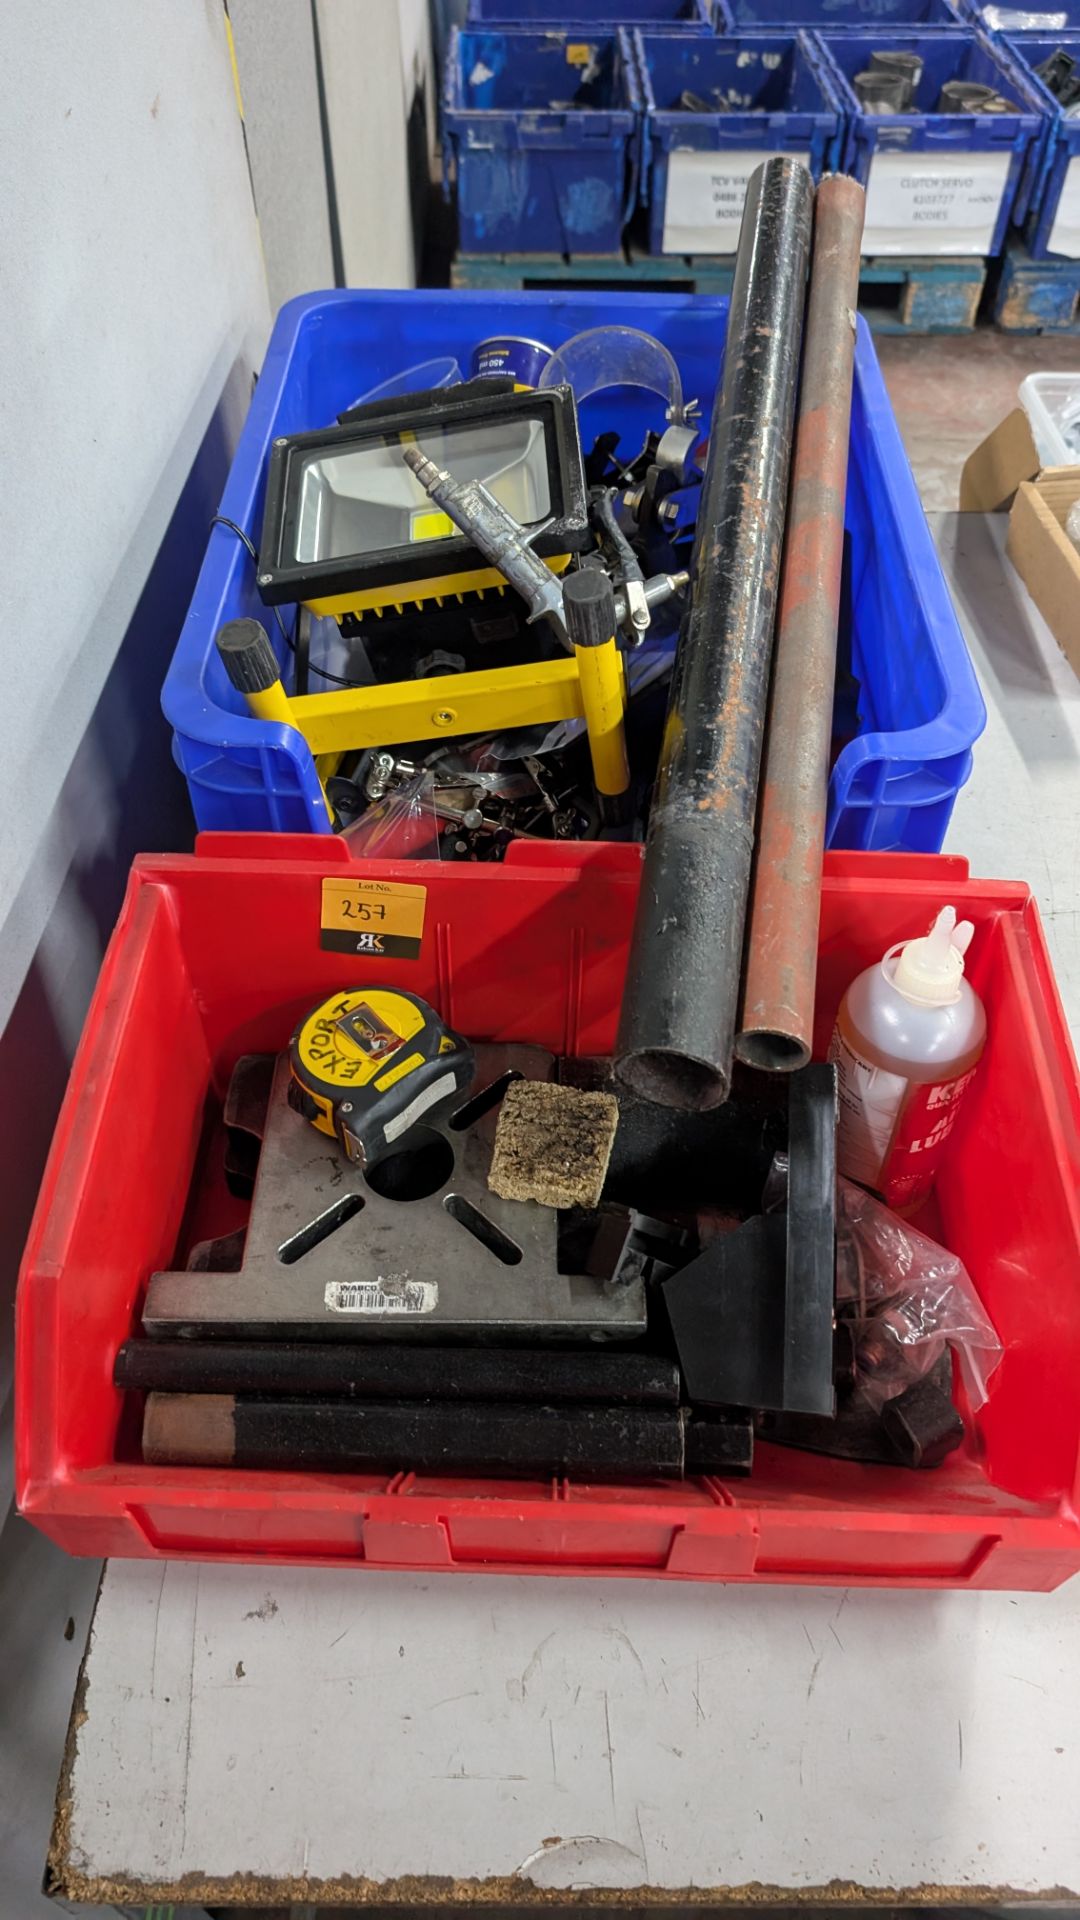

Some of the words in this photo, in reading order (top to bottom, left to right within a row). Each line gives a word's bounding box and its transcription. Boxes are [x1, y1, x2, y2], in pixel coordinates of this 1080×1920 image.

[358, 882, 374, 890] Lot
[375, 883, 392, 892] No.
[342, 899, 386, 921] 257
[308, 1000, 363, 1079] EXPORT
[340, 1284, 378, 1292] WABCO
